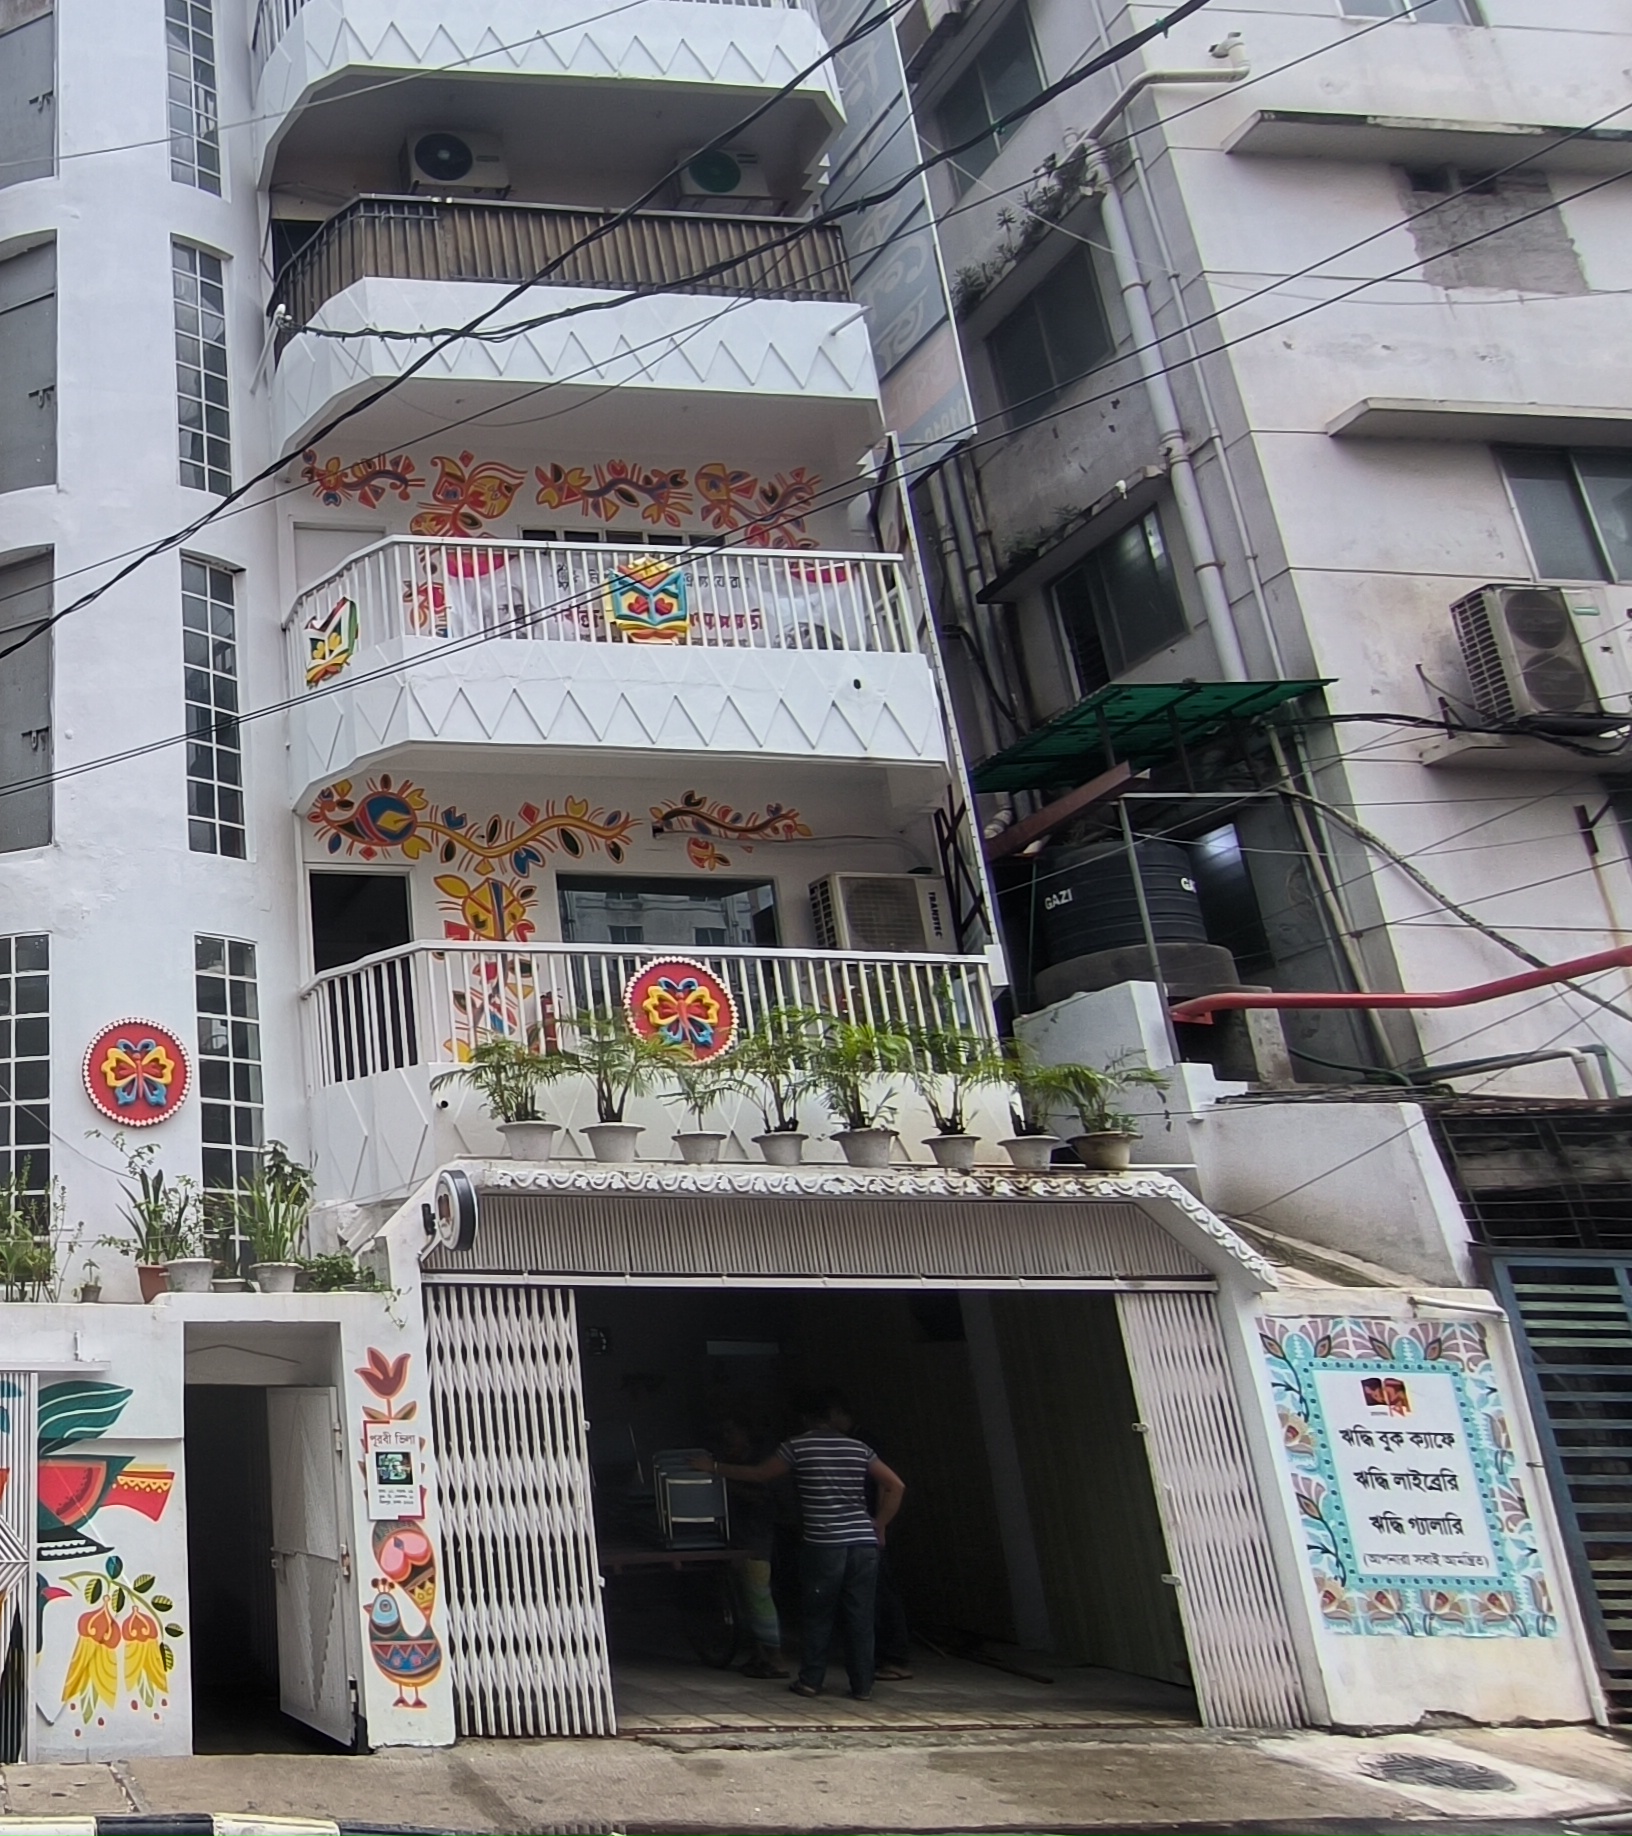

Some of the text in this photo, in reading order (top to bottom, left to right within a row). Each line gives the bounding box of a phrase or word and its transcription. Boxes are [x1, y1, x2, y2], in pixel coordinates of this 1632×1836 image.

[1044, 888, 1073, 910] GAZI
[369, 1431, 416, 1447] পূরবী ভিলা
[1377, 1430, 1404, 1453] বুক
[1406, 1430, 1456, 1450] ক্যাফে
[1393, 1467, 1461, 1492] লাইব্রেরি
[1409, 1511, 1464, 1535] গ্যালারি
